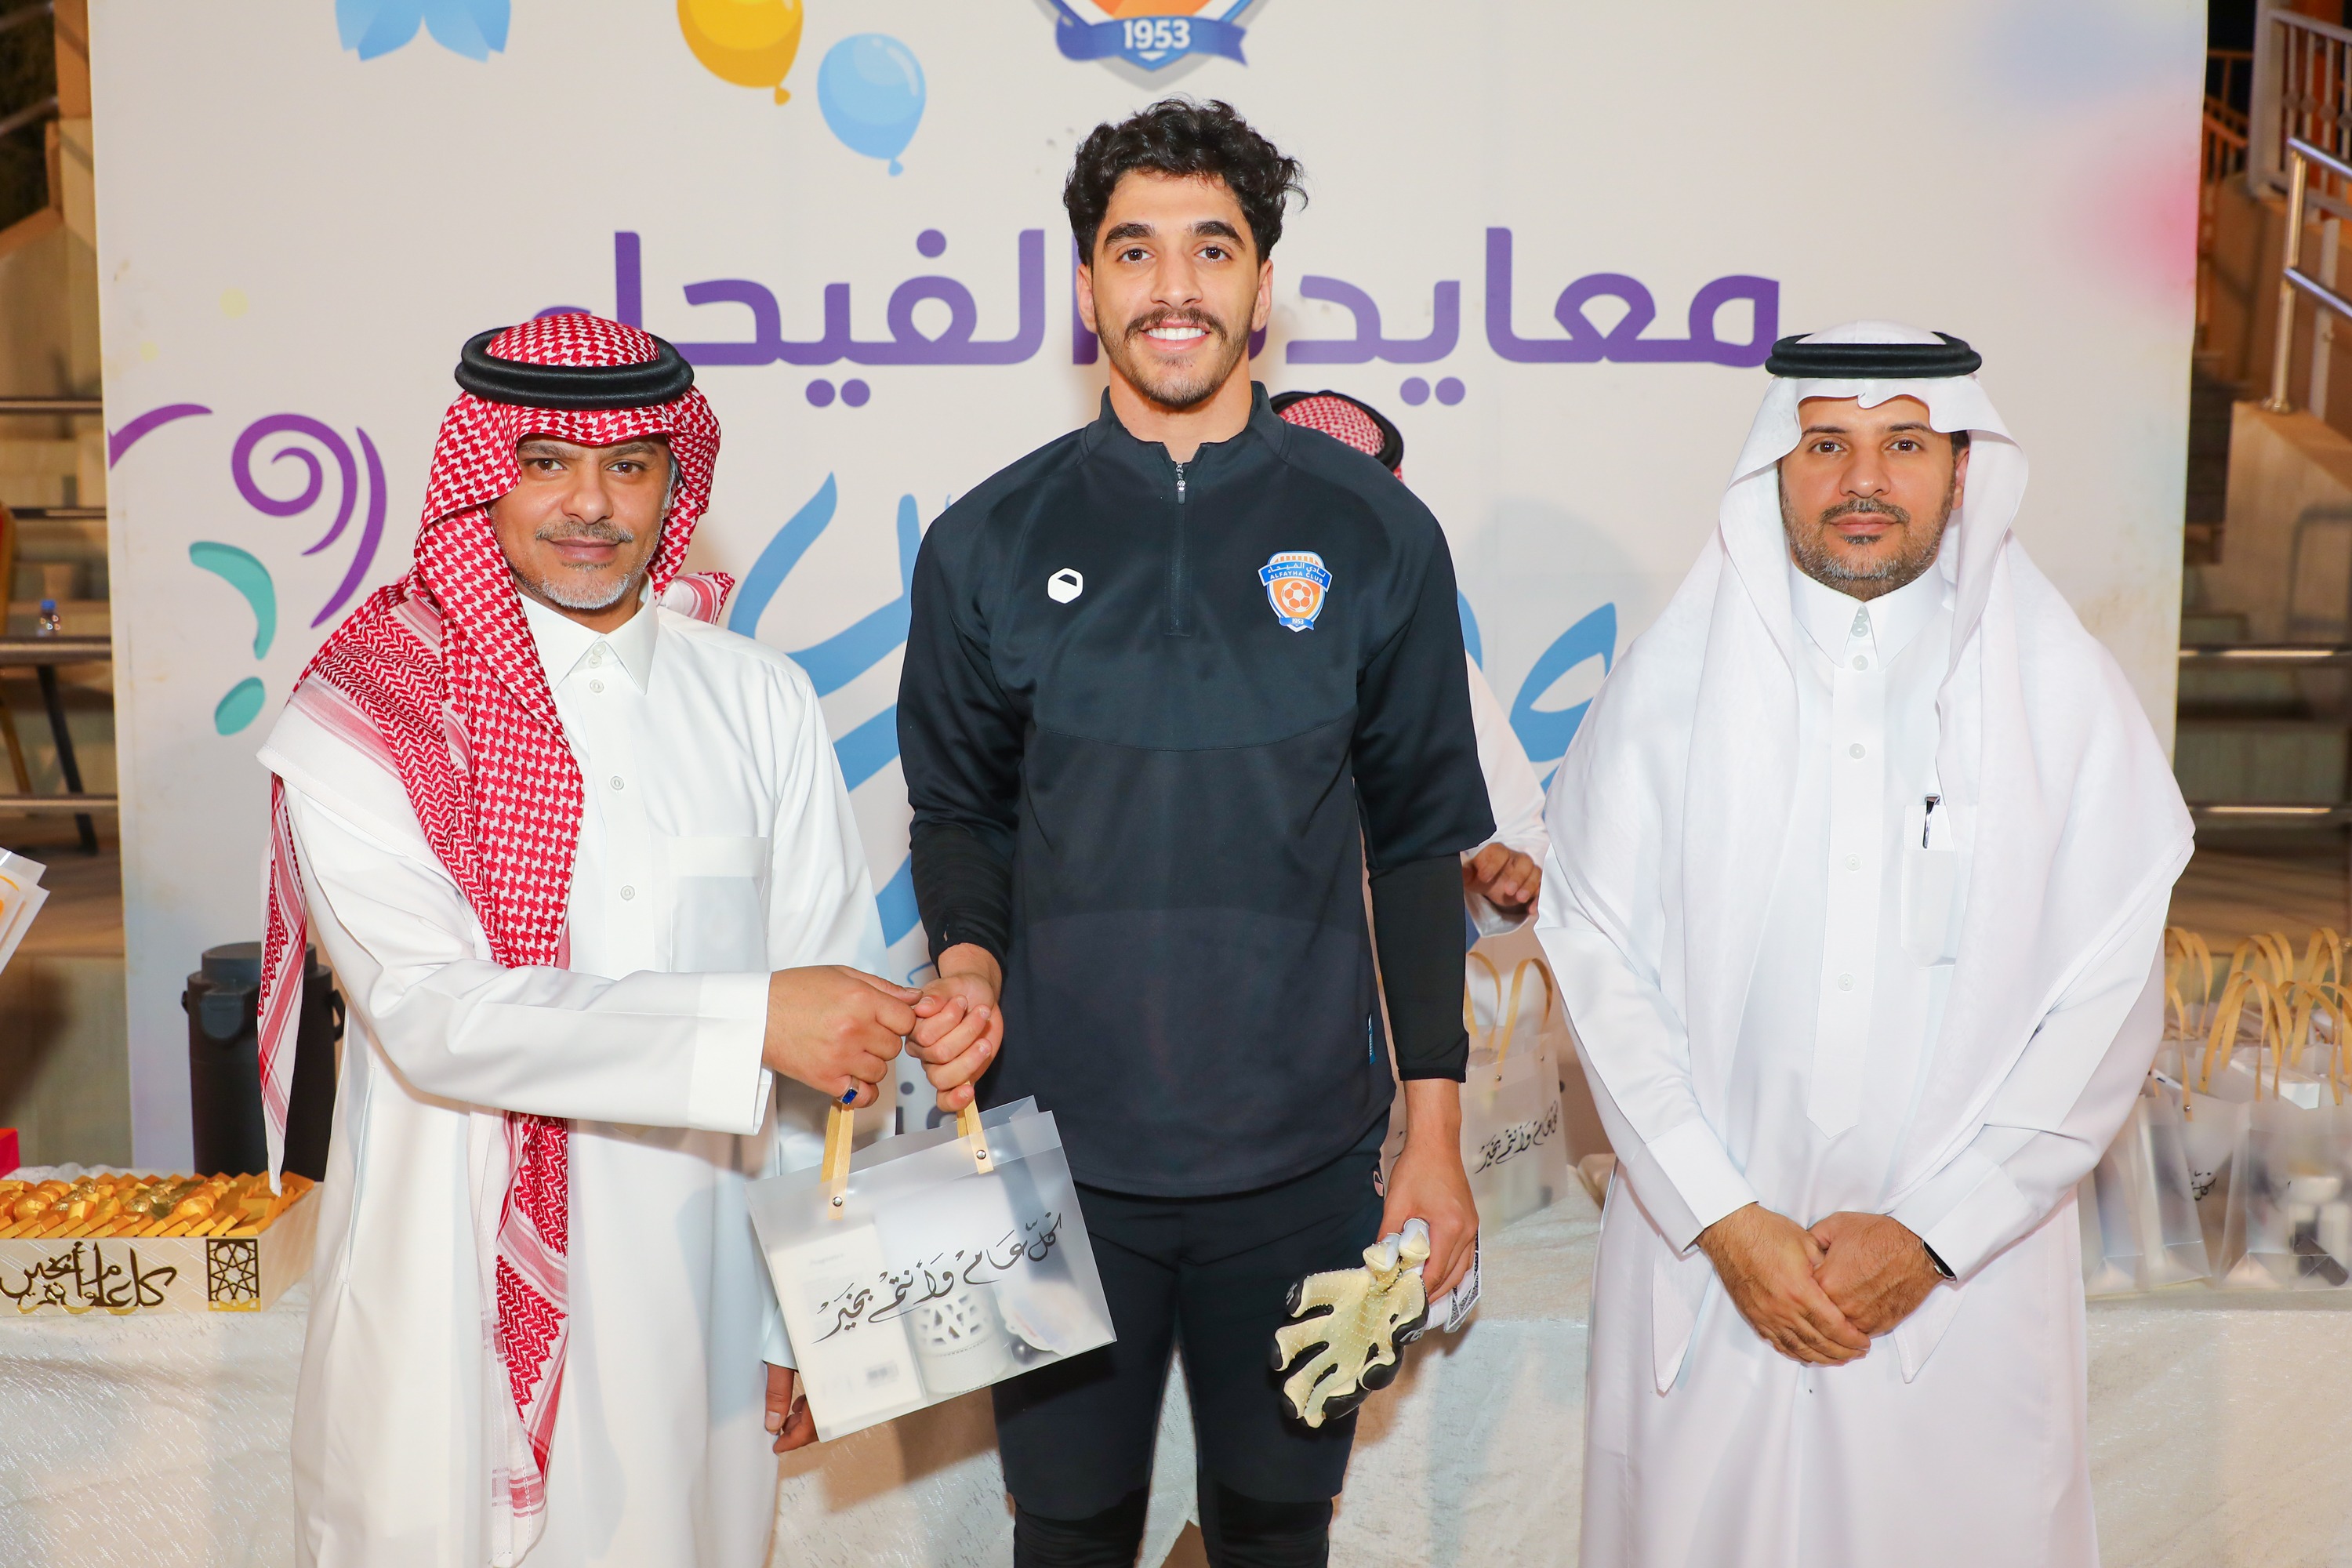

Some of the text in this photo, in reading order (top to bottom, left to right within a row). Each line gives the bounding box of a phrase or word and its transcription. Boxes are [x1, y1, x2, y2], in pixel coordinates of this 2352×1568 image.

[1123, 18, 1191, 49] 1953
[1248, 227, 1780, 407] معايد
[1270, 571, 1323, 583] ALFAYHA CLUB
